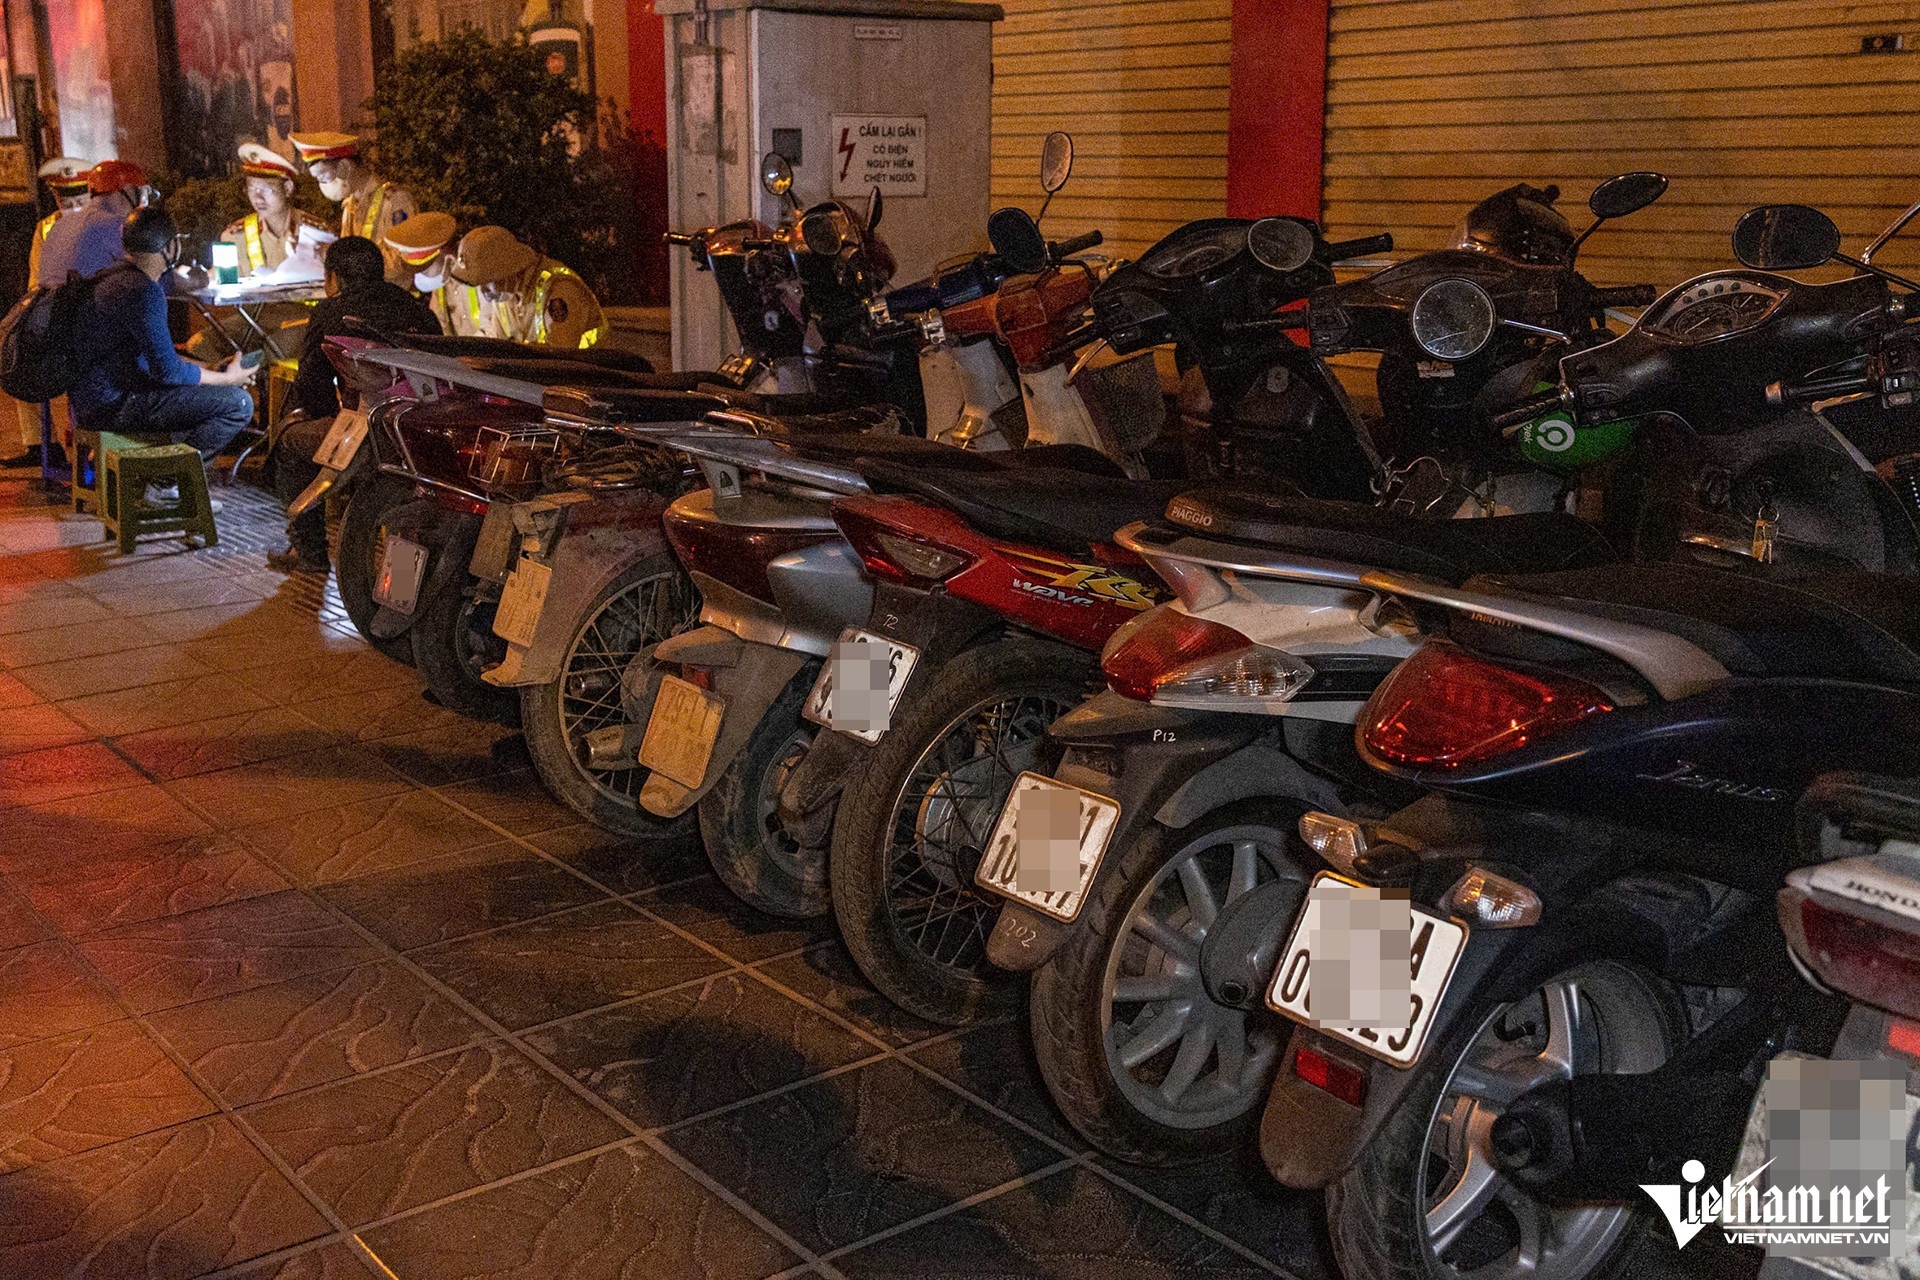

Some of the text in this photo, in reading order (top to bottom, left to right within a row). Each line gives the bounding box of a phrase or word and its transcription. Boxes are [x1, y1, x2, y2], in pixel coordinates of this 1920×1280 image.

[859, 121, 879, 137] CẤM
[867, 160, 890, 169] NGUY
[1171, 506, 1212, 527] PIAGGIO
[1153, 728, 1176, 742] P12
[1846, 881, 1920, 908] HOND
